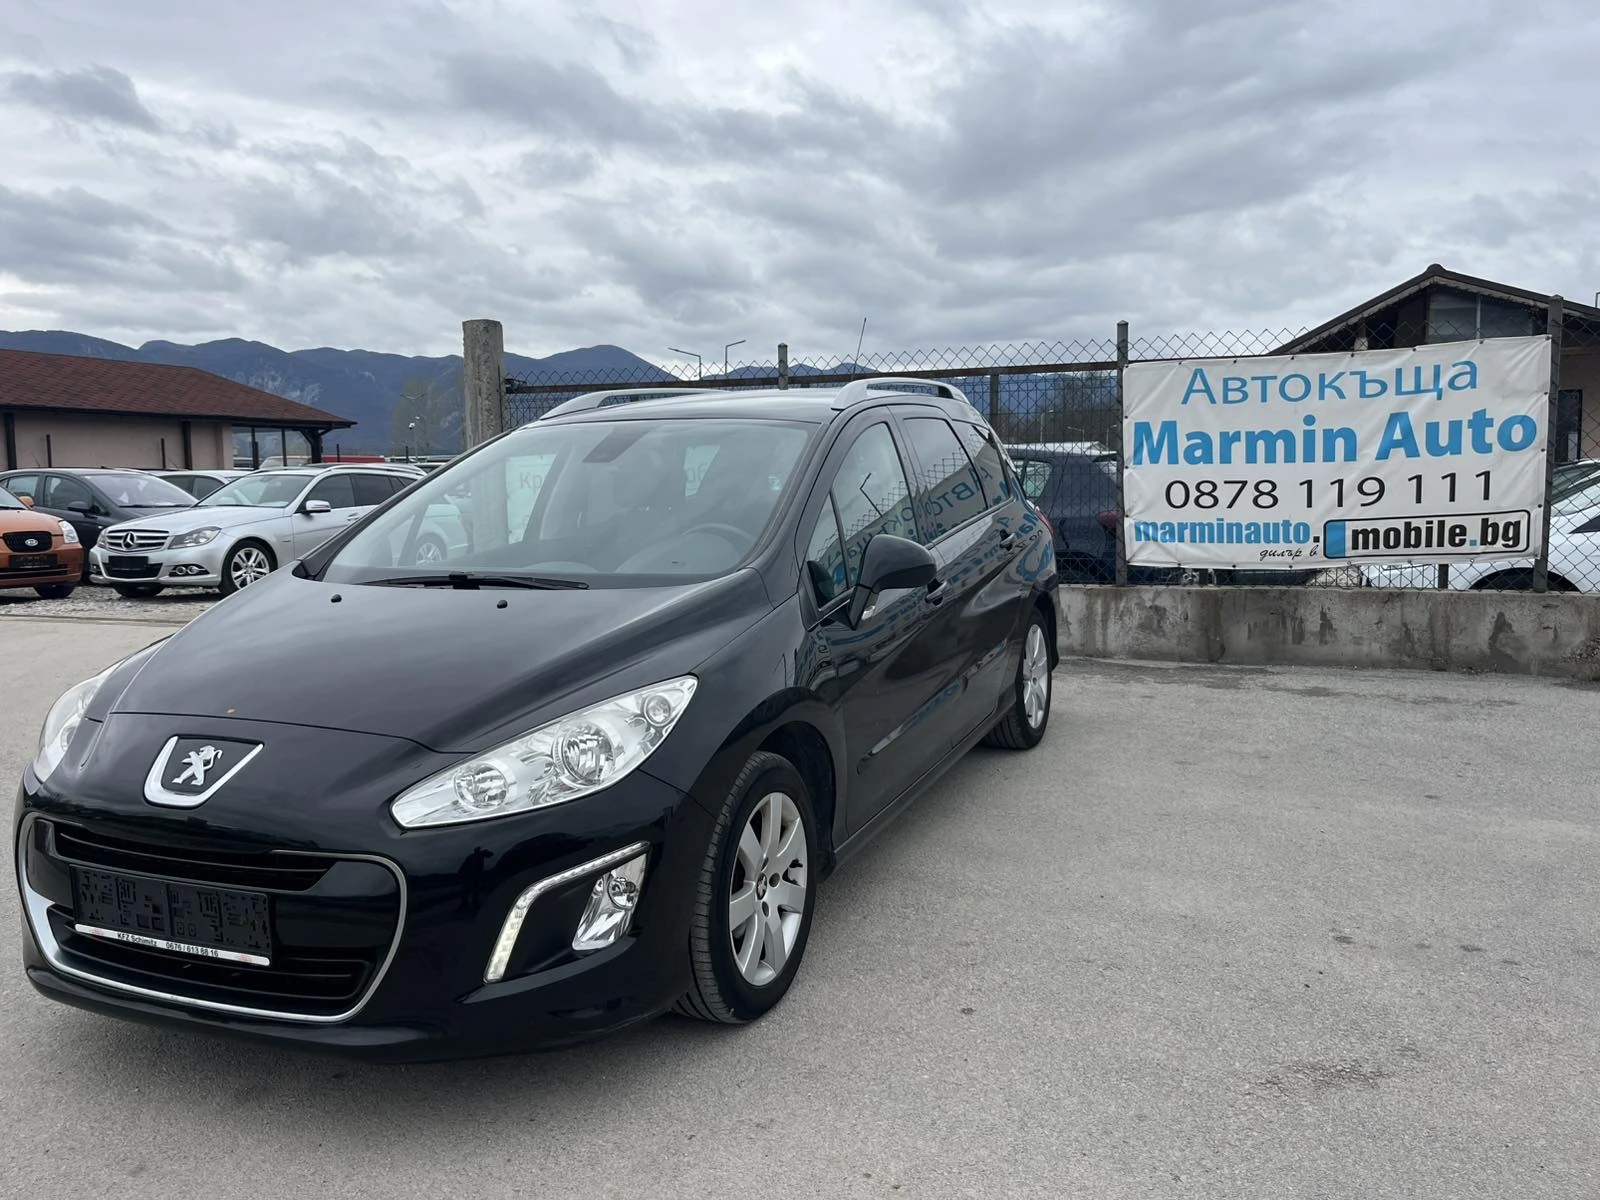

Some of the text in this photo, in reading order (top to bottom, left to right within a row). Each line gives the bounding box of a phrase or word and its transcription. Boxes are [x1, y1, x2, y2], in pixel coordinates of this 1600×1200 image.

[1181, 360, 1477, 405] Автокъща
[1132, 408, 1537, 466] Marmin Auto
[1165, 470, 1490, 509] 0878 119 111
[1352, 518, 1522, 550] mobile.bg
